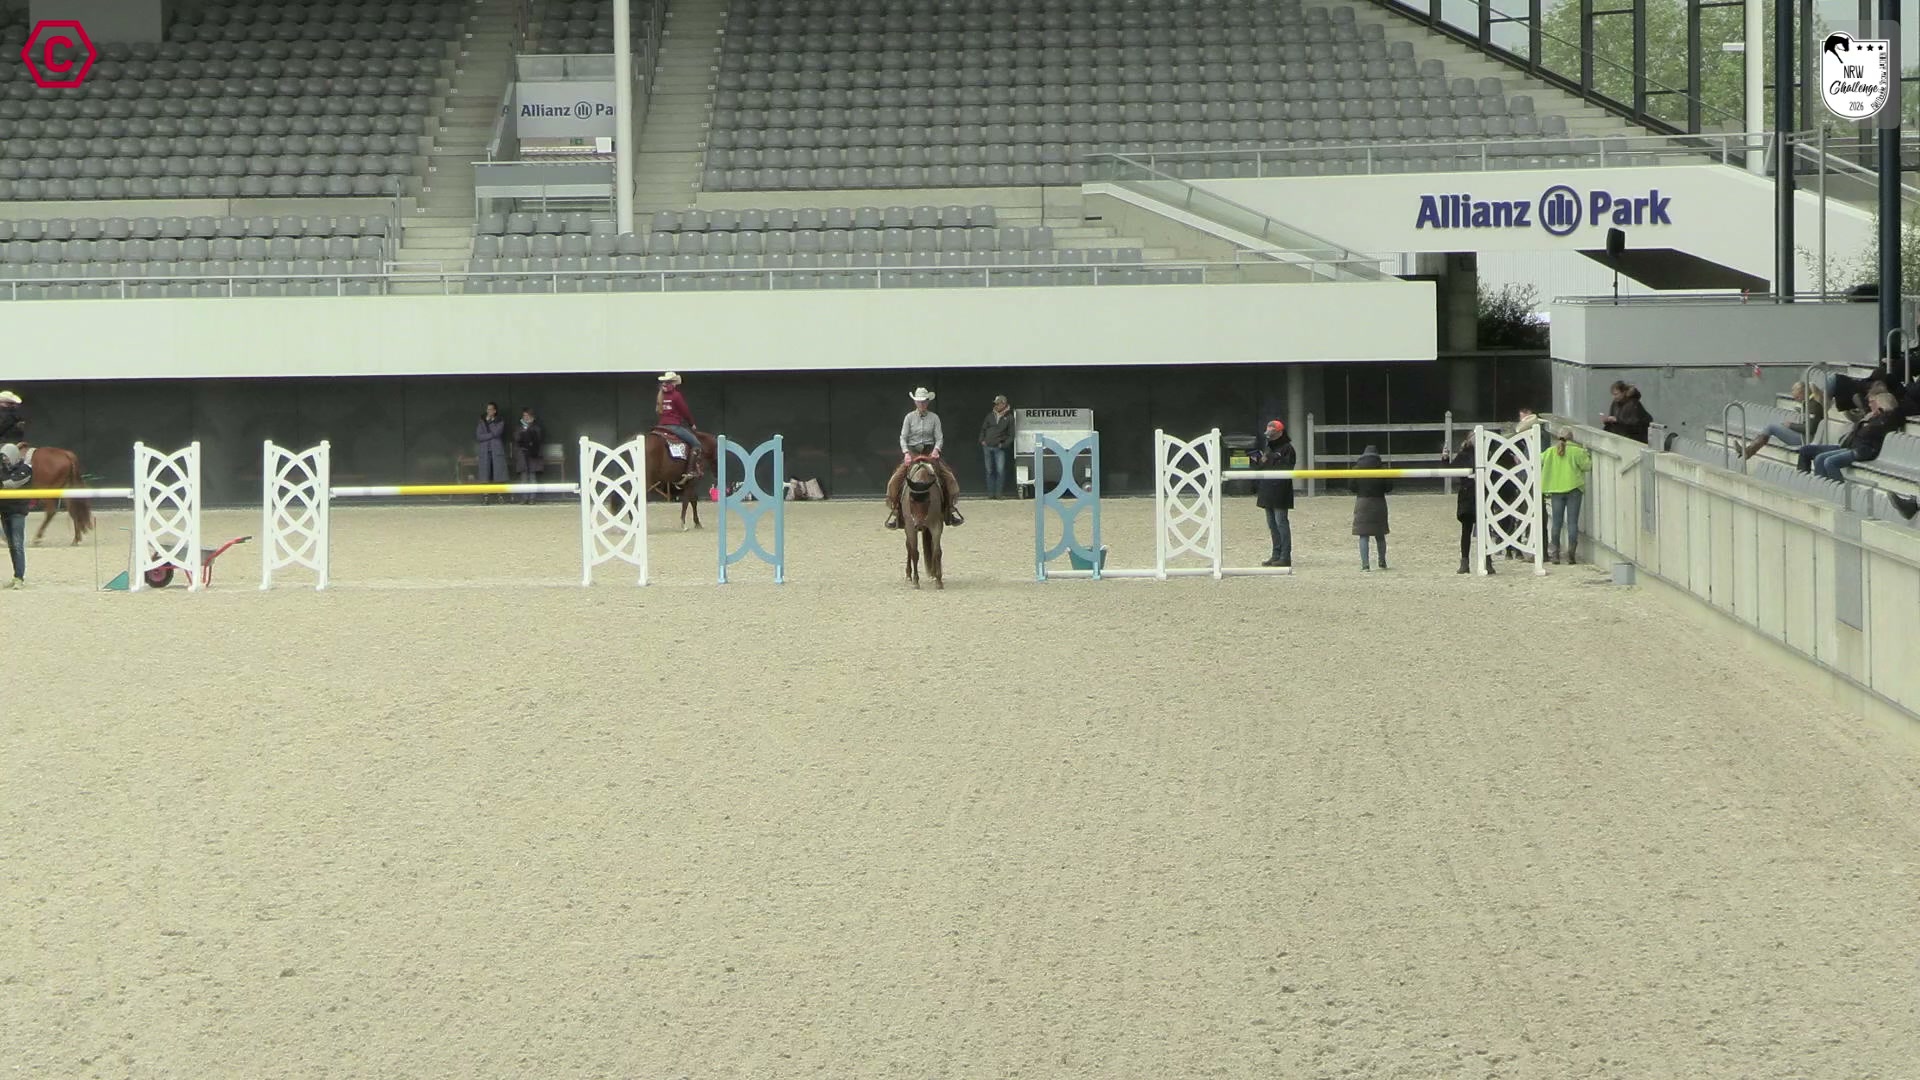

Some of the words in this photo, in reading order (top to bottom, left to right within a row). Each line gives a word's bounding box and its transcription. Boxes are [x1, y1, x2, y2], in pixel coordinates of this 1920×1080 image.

[521, 104, 571, 117] Allianz
[595, 103, 616, 116] Pa
[1415, 194, 1531, 229] Allianz
[1590, 190, 1672, 226] Park
[1025, 409, 1079, 418] REITERLIVE
